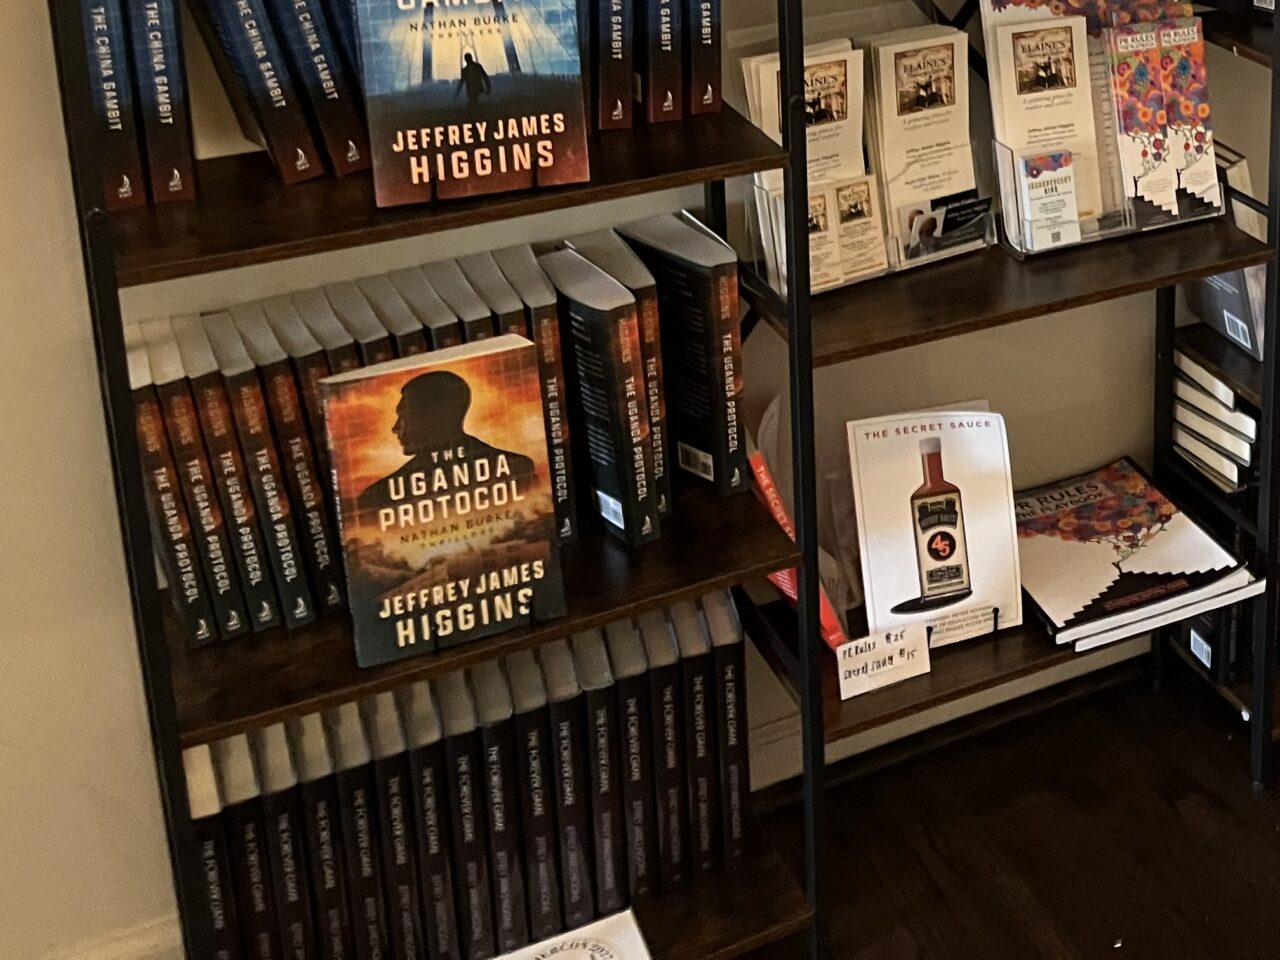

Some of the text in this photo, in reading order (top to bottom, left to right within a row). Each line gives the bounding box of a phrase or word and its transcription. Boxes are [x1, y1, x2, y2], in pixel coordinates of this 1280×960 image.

[409, 12, 519, 33] NATHAN BURKE
[701, 2, 711, 45] GAMBIT
[392, 112, 566, 153] JEFFREY JAMES
[409, 139, 555, 185] HIGGINS
[722, 333, 738, 454] THE UGANDA PROTOCOL
[864, 420, 991, 440] THE SECRET SAUCE
[431, 445, 465, 462] THE
[387, 454, 511, 501] UGANDA
[1037, 482, 1099, 506] RULES
[379, 480, 525, 533] PROTOCOL
[931, 535, 950, 556] 45
[379, 559, 544, 619] JEFFREY JAMES
[395, 587, 534, 647] HIGGINS
